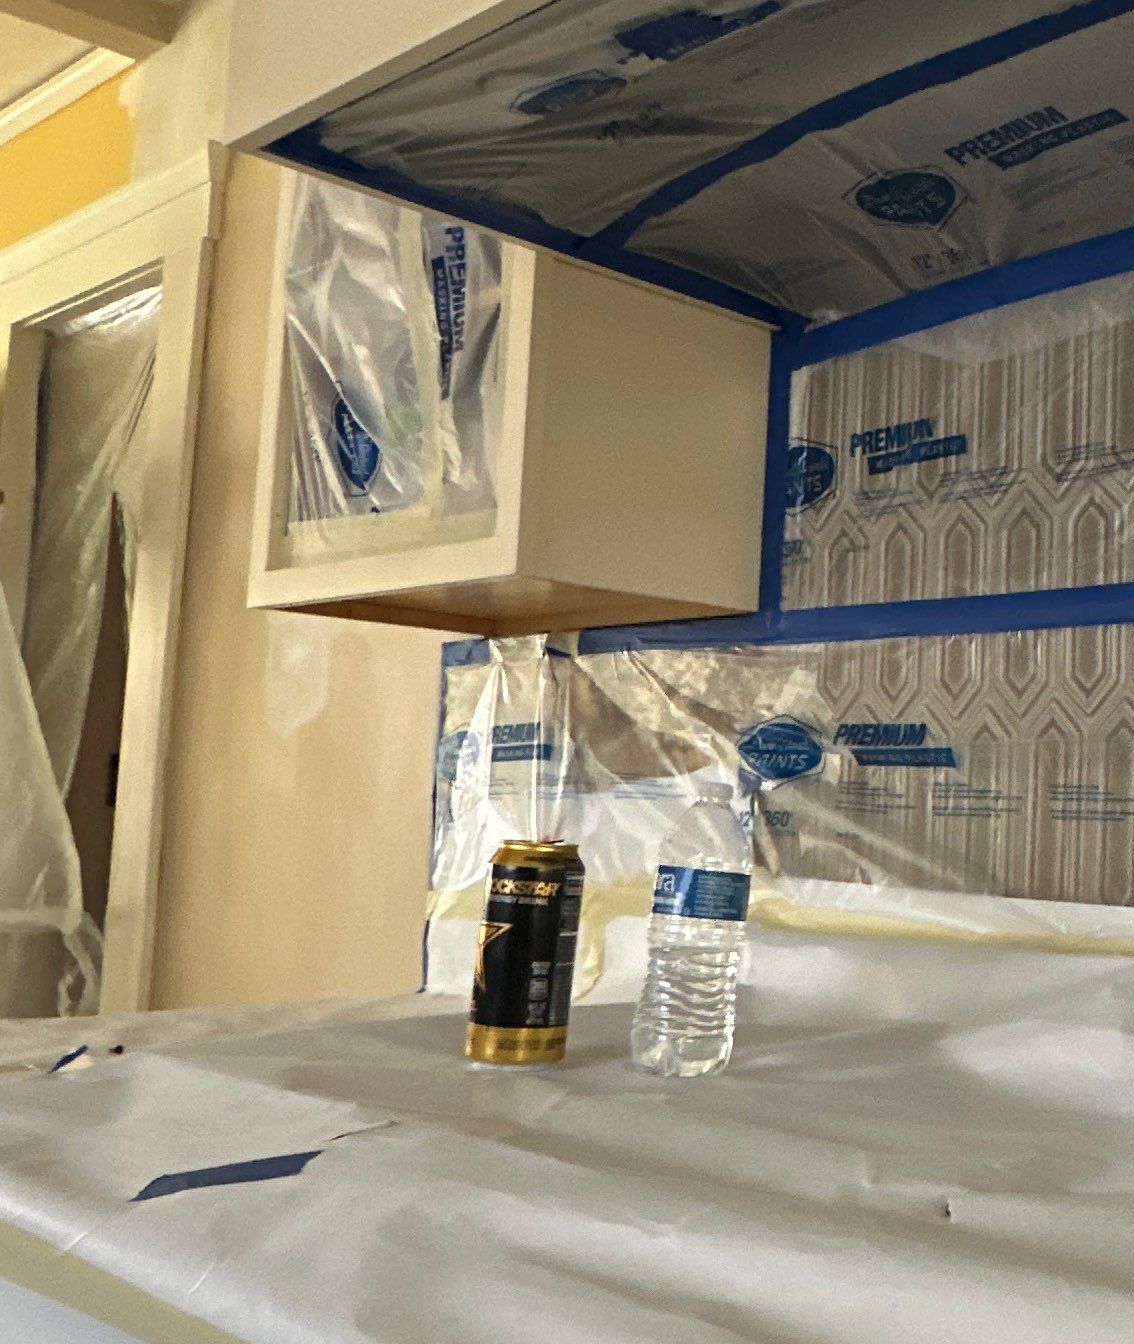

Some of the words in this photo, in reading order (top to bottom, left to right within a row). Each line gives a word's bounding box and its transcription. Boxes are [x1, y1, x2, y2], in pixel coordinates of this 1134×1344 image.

[945, 106, 1069, 167] PREMIUM
[445, 226, 467, 353] PREMIUM
[834, 723, 928, 746] PREMIUM
